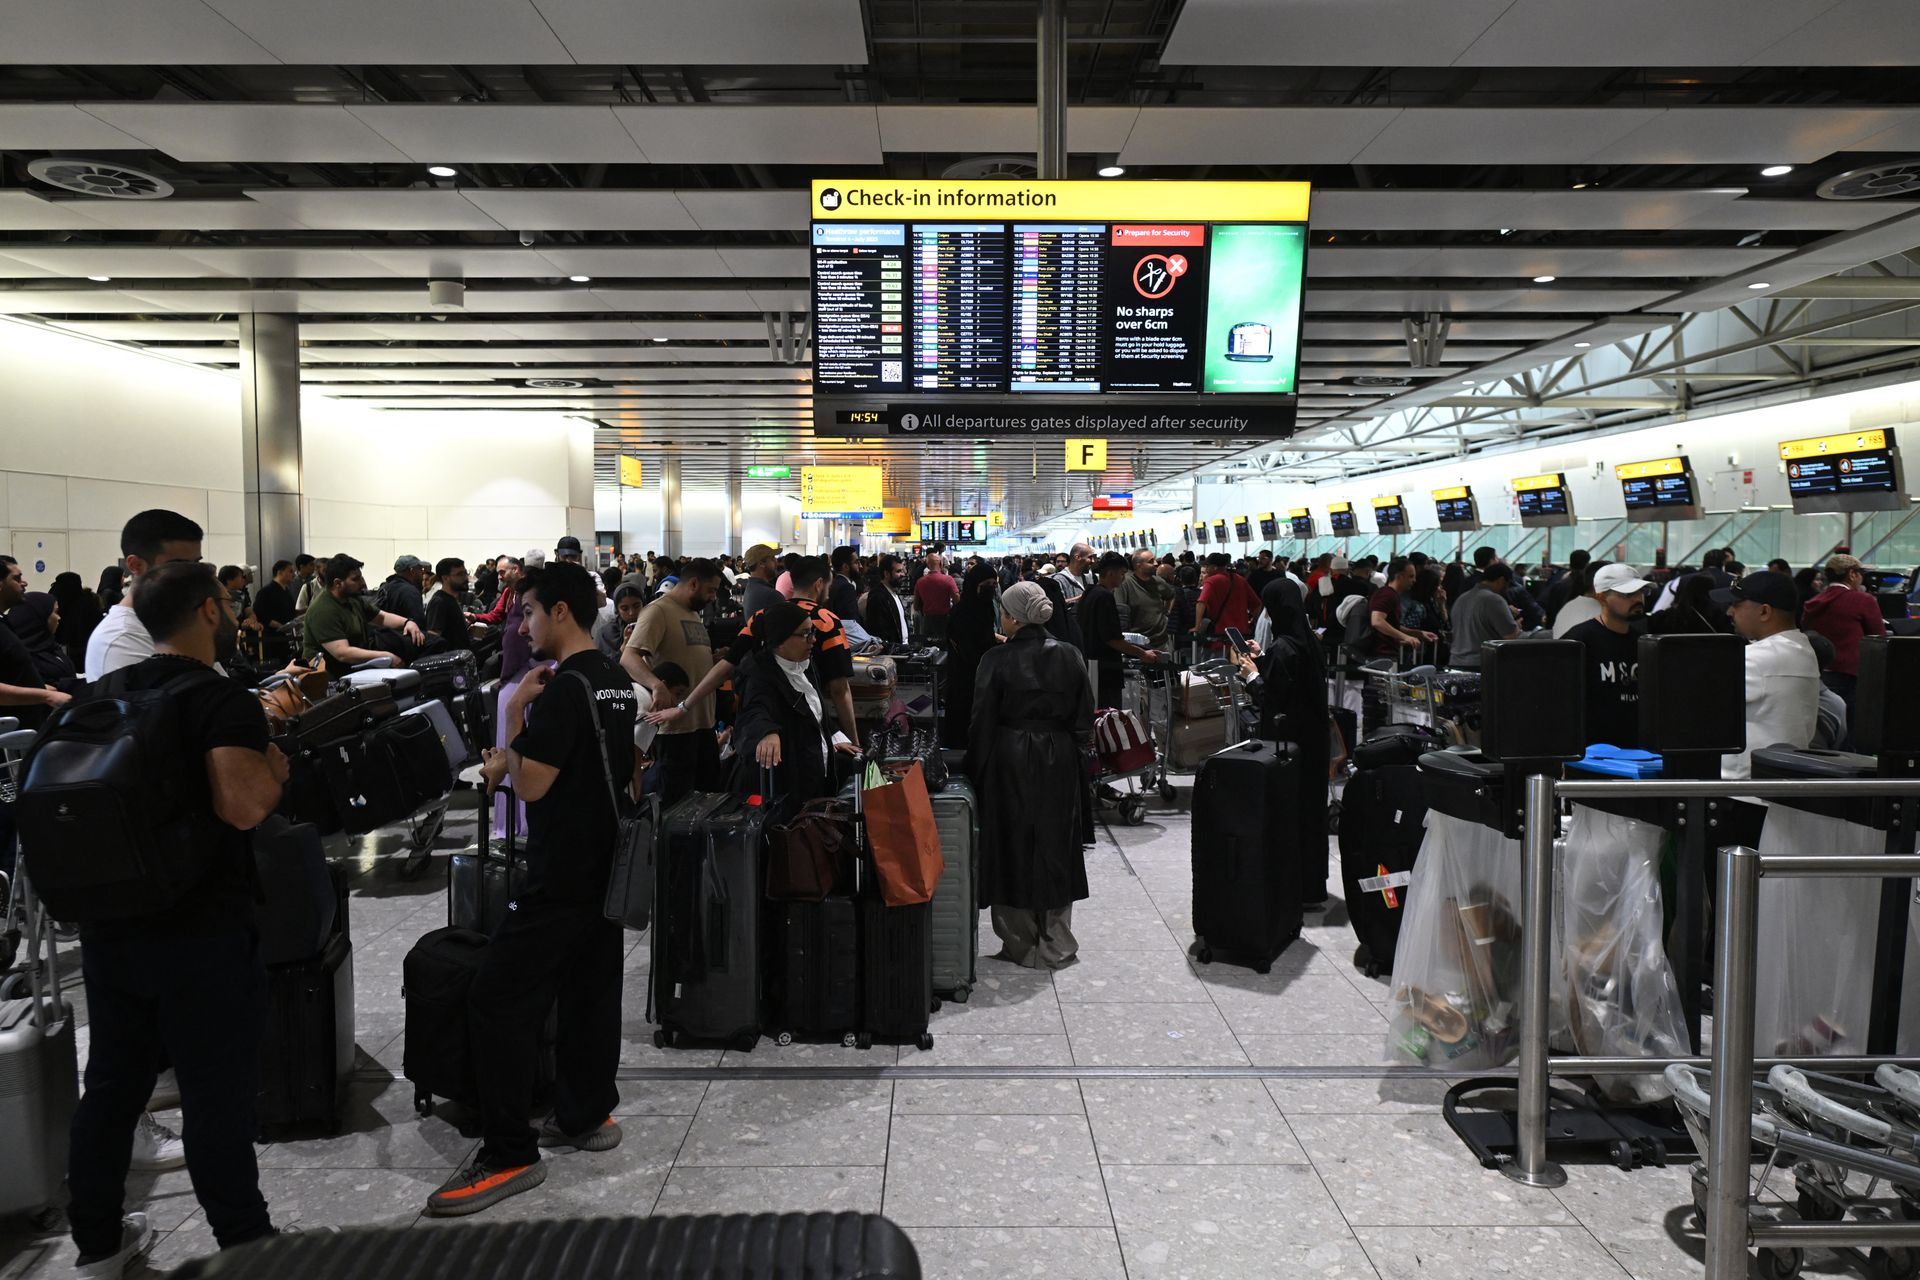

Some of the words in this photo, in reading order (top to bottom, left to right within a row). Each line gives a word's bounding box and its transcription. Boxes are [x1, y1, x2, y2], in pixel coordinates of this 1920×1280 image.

[847, 189, 930, 205] Check-in
[938, 189, 1056, 206] information
[1117, 307, 1133, 316] No
[1136, 306, 1173, 321] sharps
[1116, 321, 1142, 329] over
[1145, 319, 1167, 329] 6cm
[851, 409, 878, 422] 14:54
[922, 415, 941, 428] All
[945, 415, 1027, 432] departures
[1030, 417, 1071, 432] gates
[1074, 415, 1147, 432] displayed
[1150, 415, 1186, 429] after
[1189, 416, 1249, 432] security
[1082, 445, 1094, 465] F
